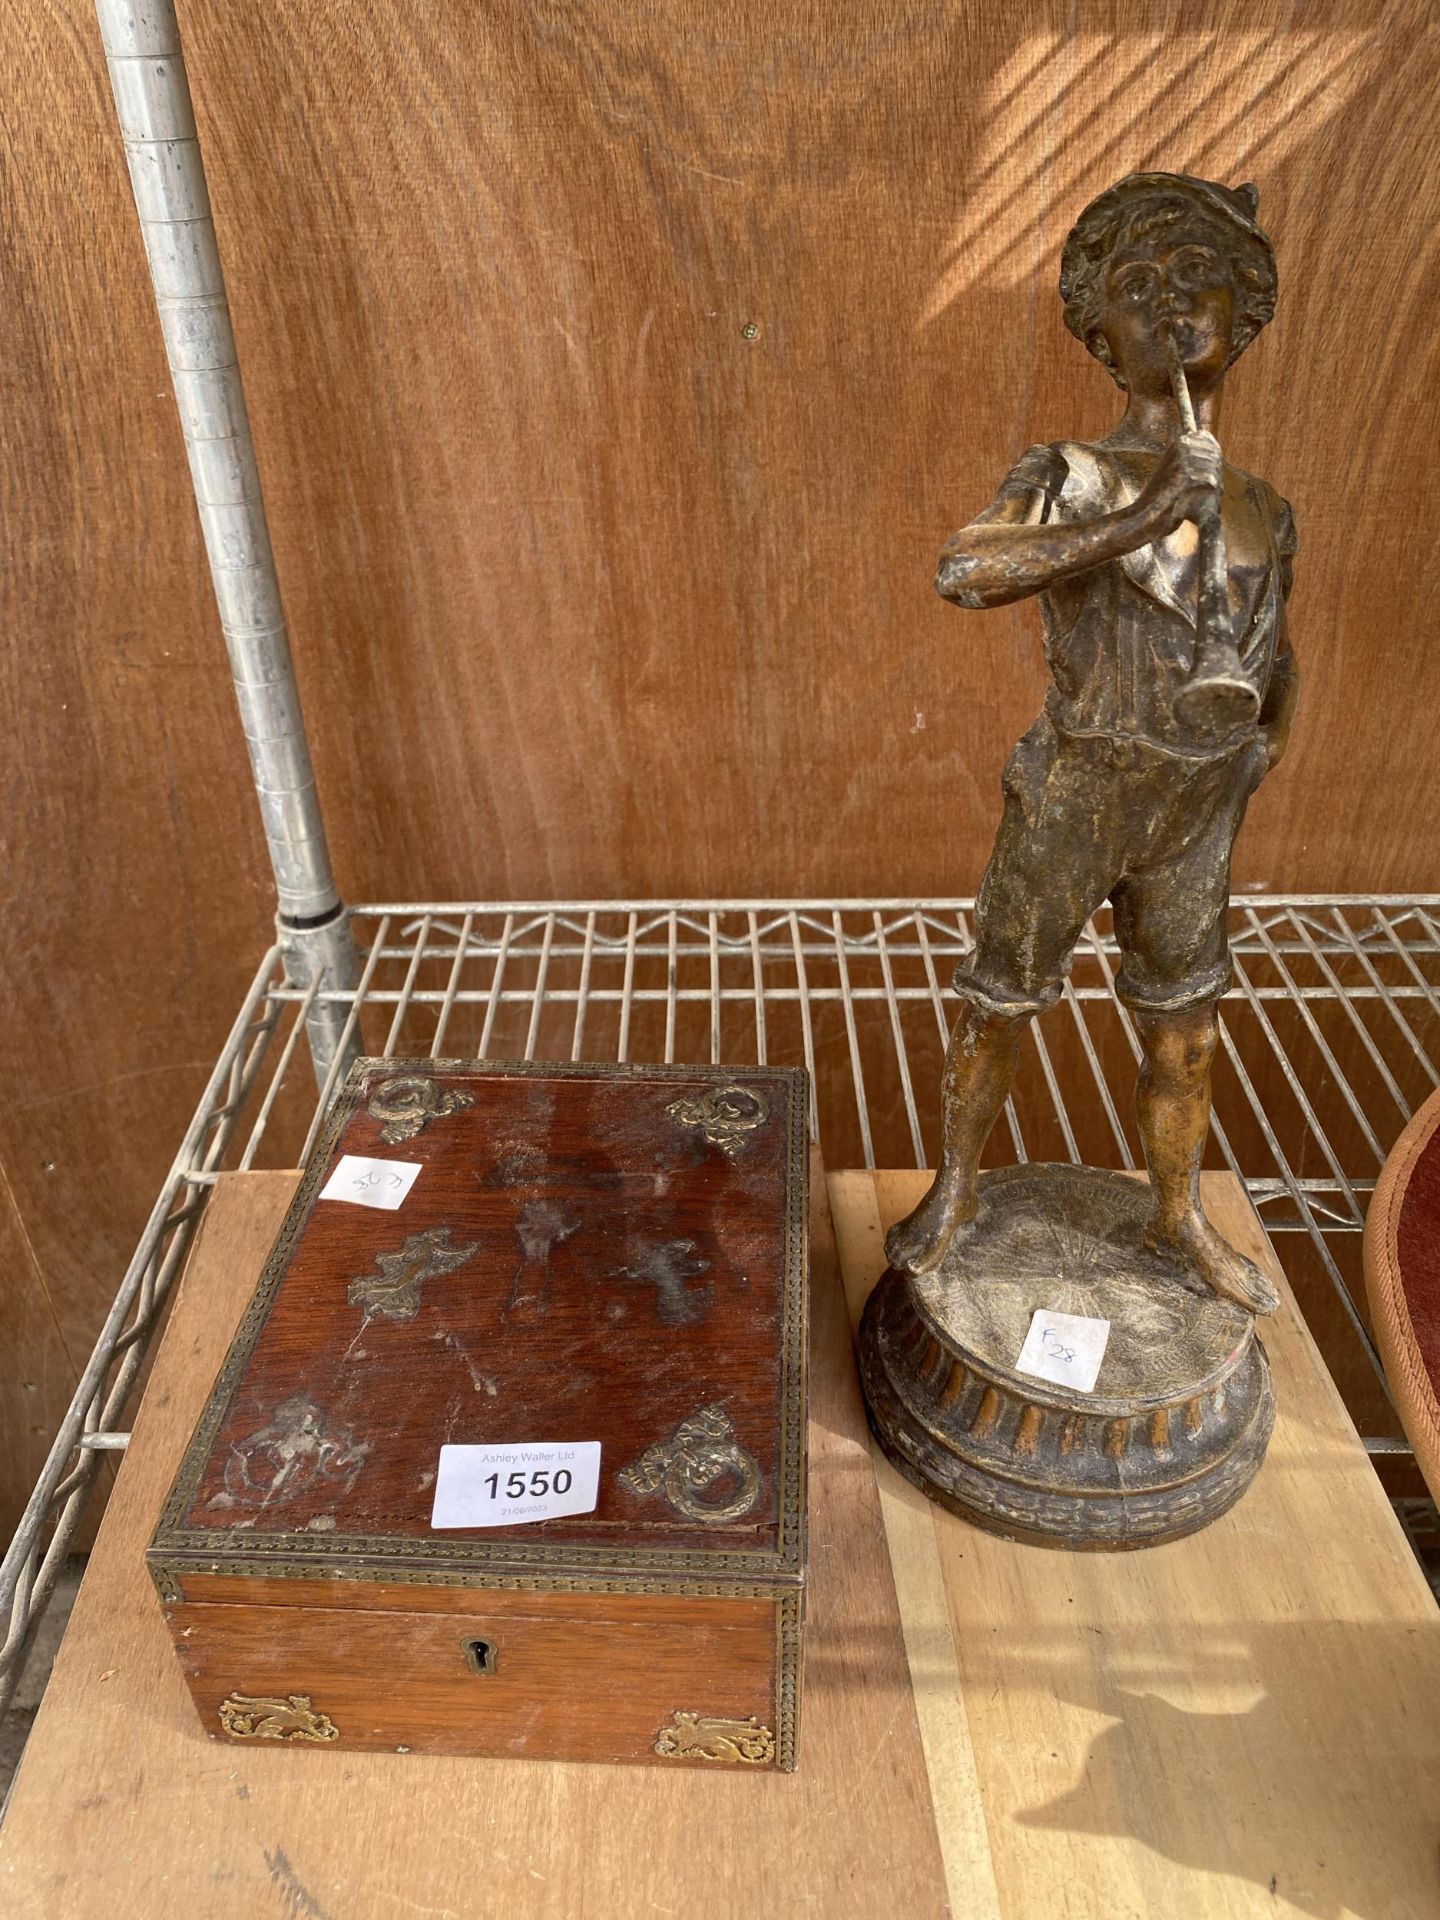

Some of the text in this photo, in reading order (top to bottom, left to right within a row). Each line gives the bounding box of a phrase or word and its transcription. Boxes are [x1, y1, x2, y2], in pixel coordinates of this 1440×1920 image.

[1041, 1328, 1056, 1343] F
[1048, 1343, 1077, 1363] 28
[482, 1451, 575, 1465] Ashley Waller Ltd
[484, 1469, 572, 1499] 1550
